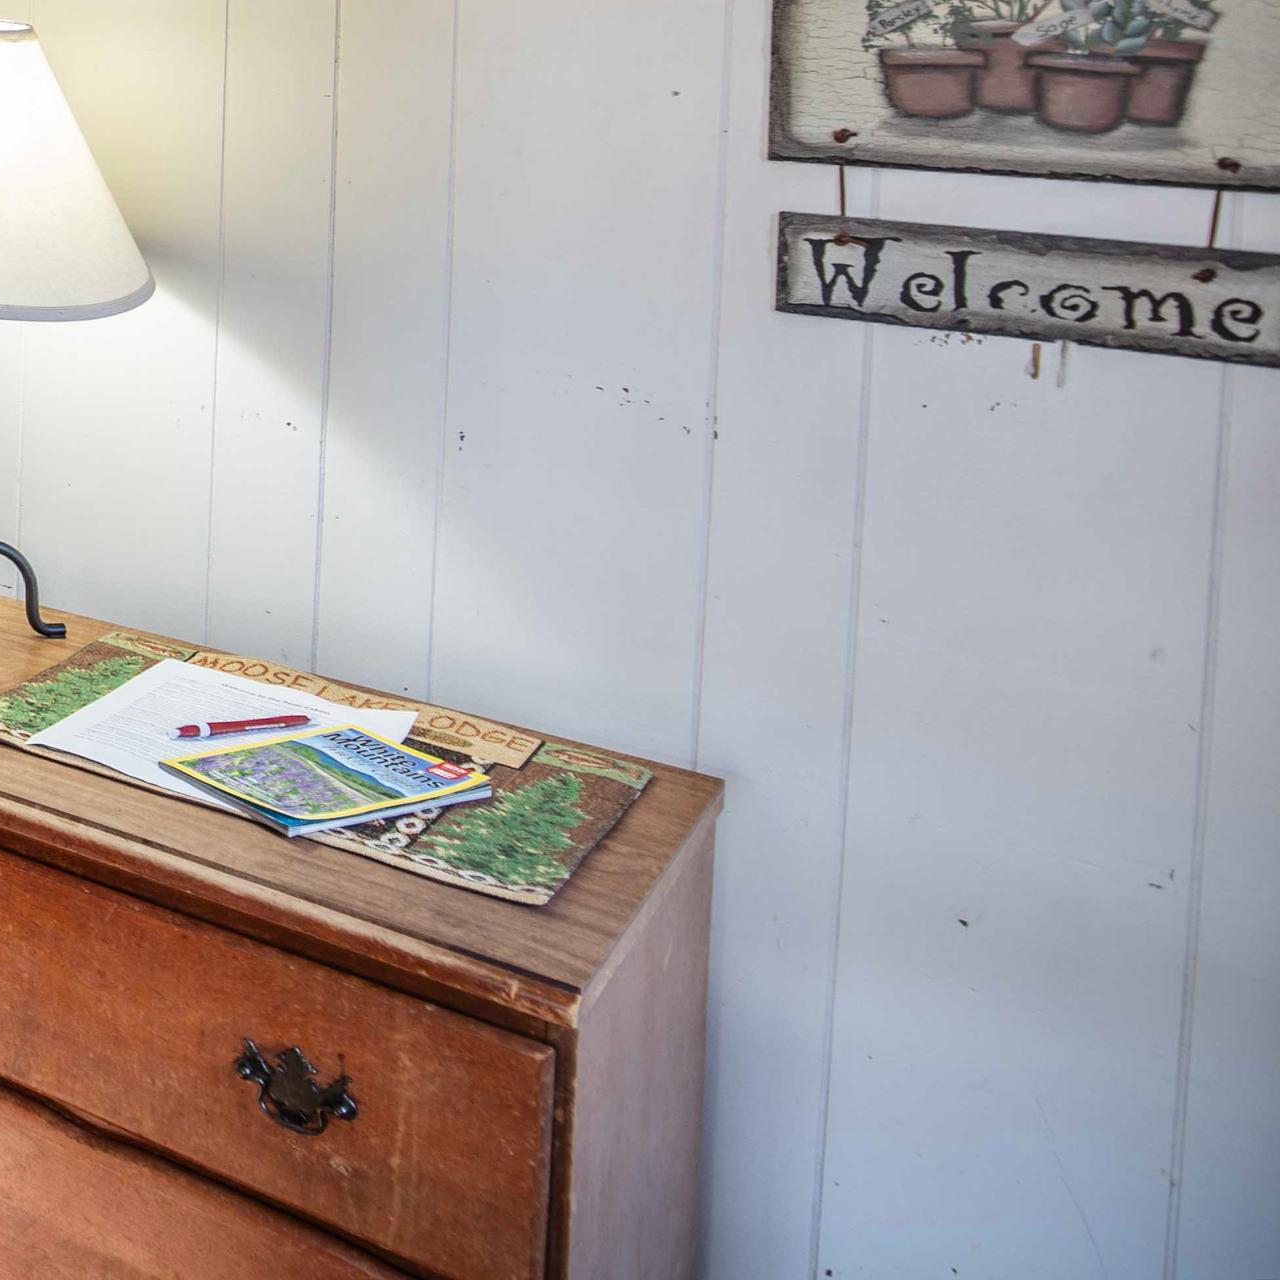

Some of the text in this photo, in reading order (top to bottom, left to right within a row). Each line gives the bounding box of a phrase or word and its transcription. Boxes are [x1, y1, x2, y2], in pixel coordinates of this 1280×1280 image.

[1035, 15, 1078, 38] Sage
[802, 236, 1265, 343] Welcome
[350, 734, 417, 768] White
[428, 715, 536, 753] ODGE
[322, 732, 445, 789] Mountains
